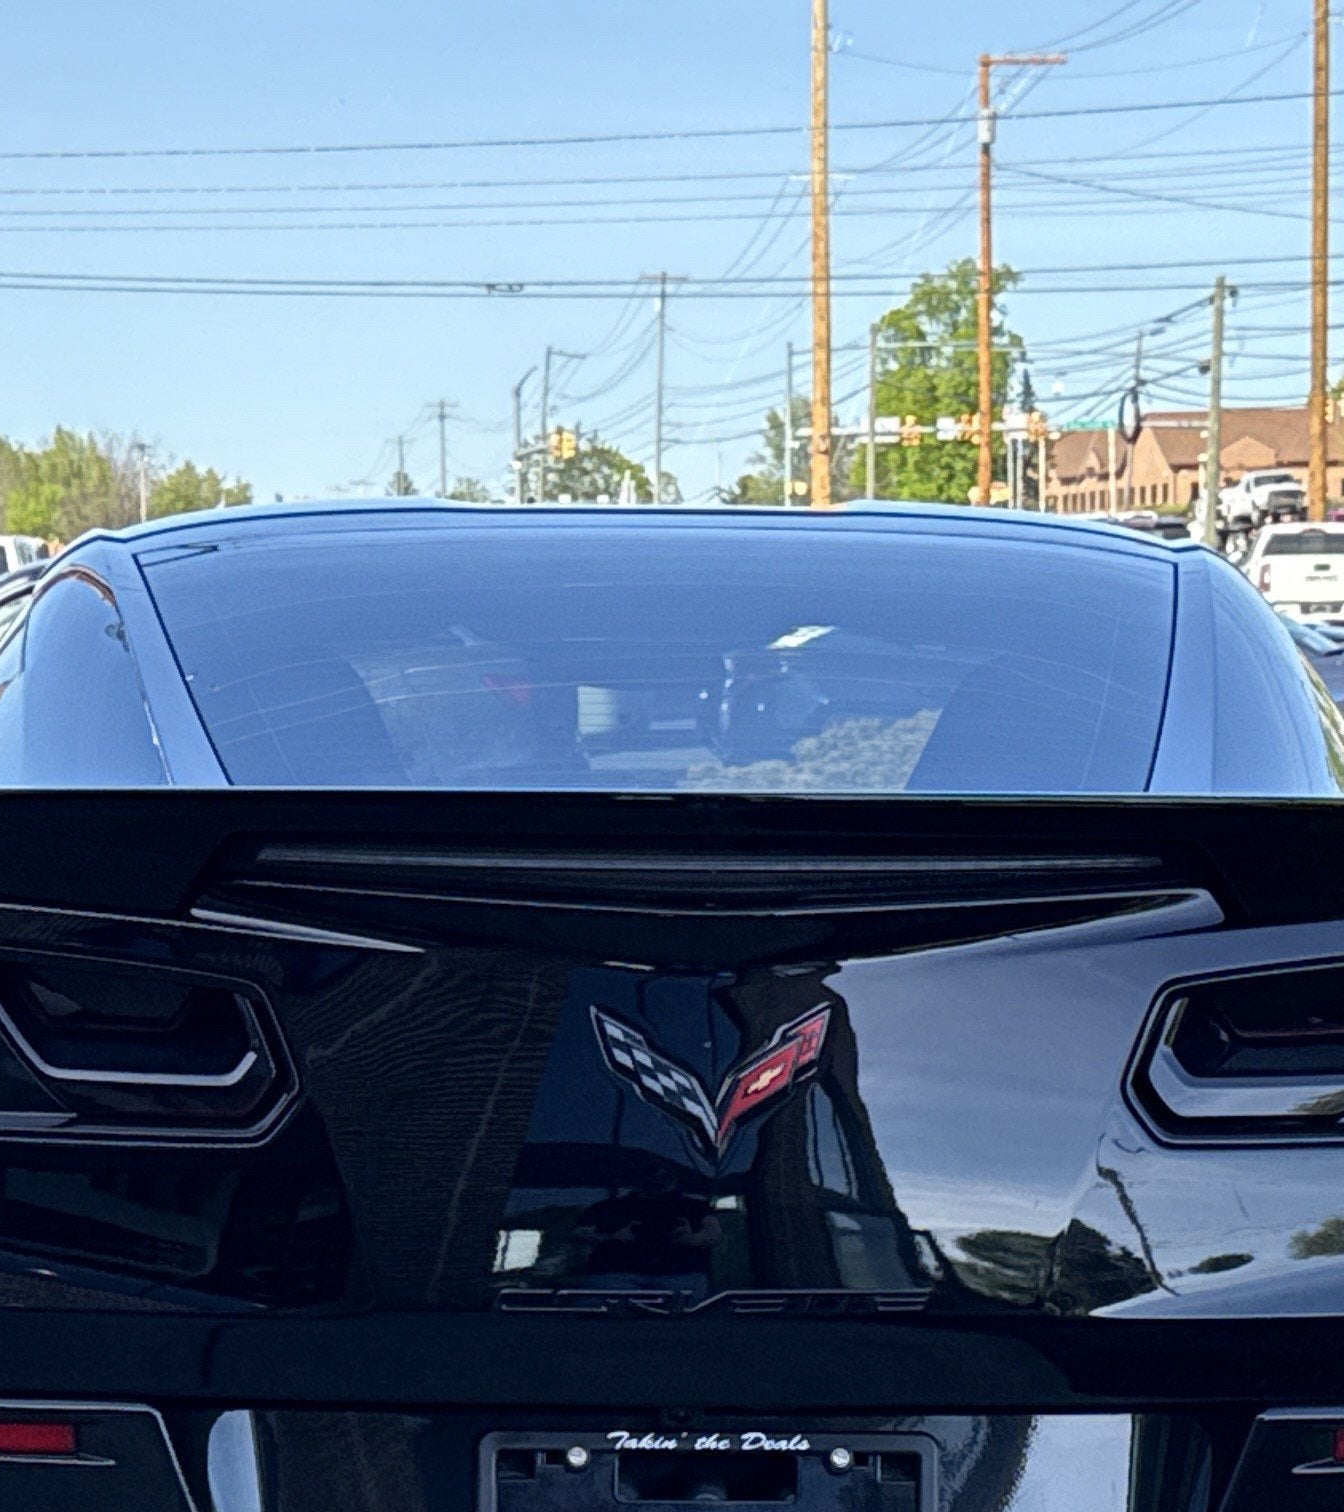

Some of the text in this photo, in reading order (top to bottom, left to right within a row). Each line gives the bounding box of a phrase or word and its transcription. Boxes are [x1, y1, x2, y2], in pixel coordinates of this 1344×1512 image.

[606, 1431, 810, 1450] Takin' the Deals
